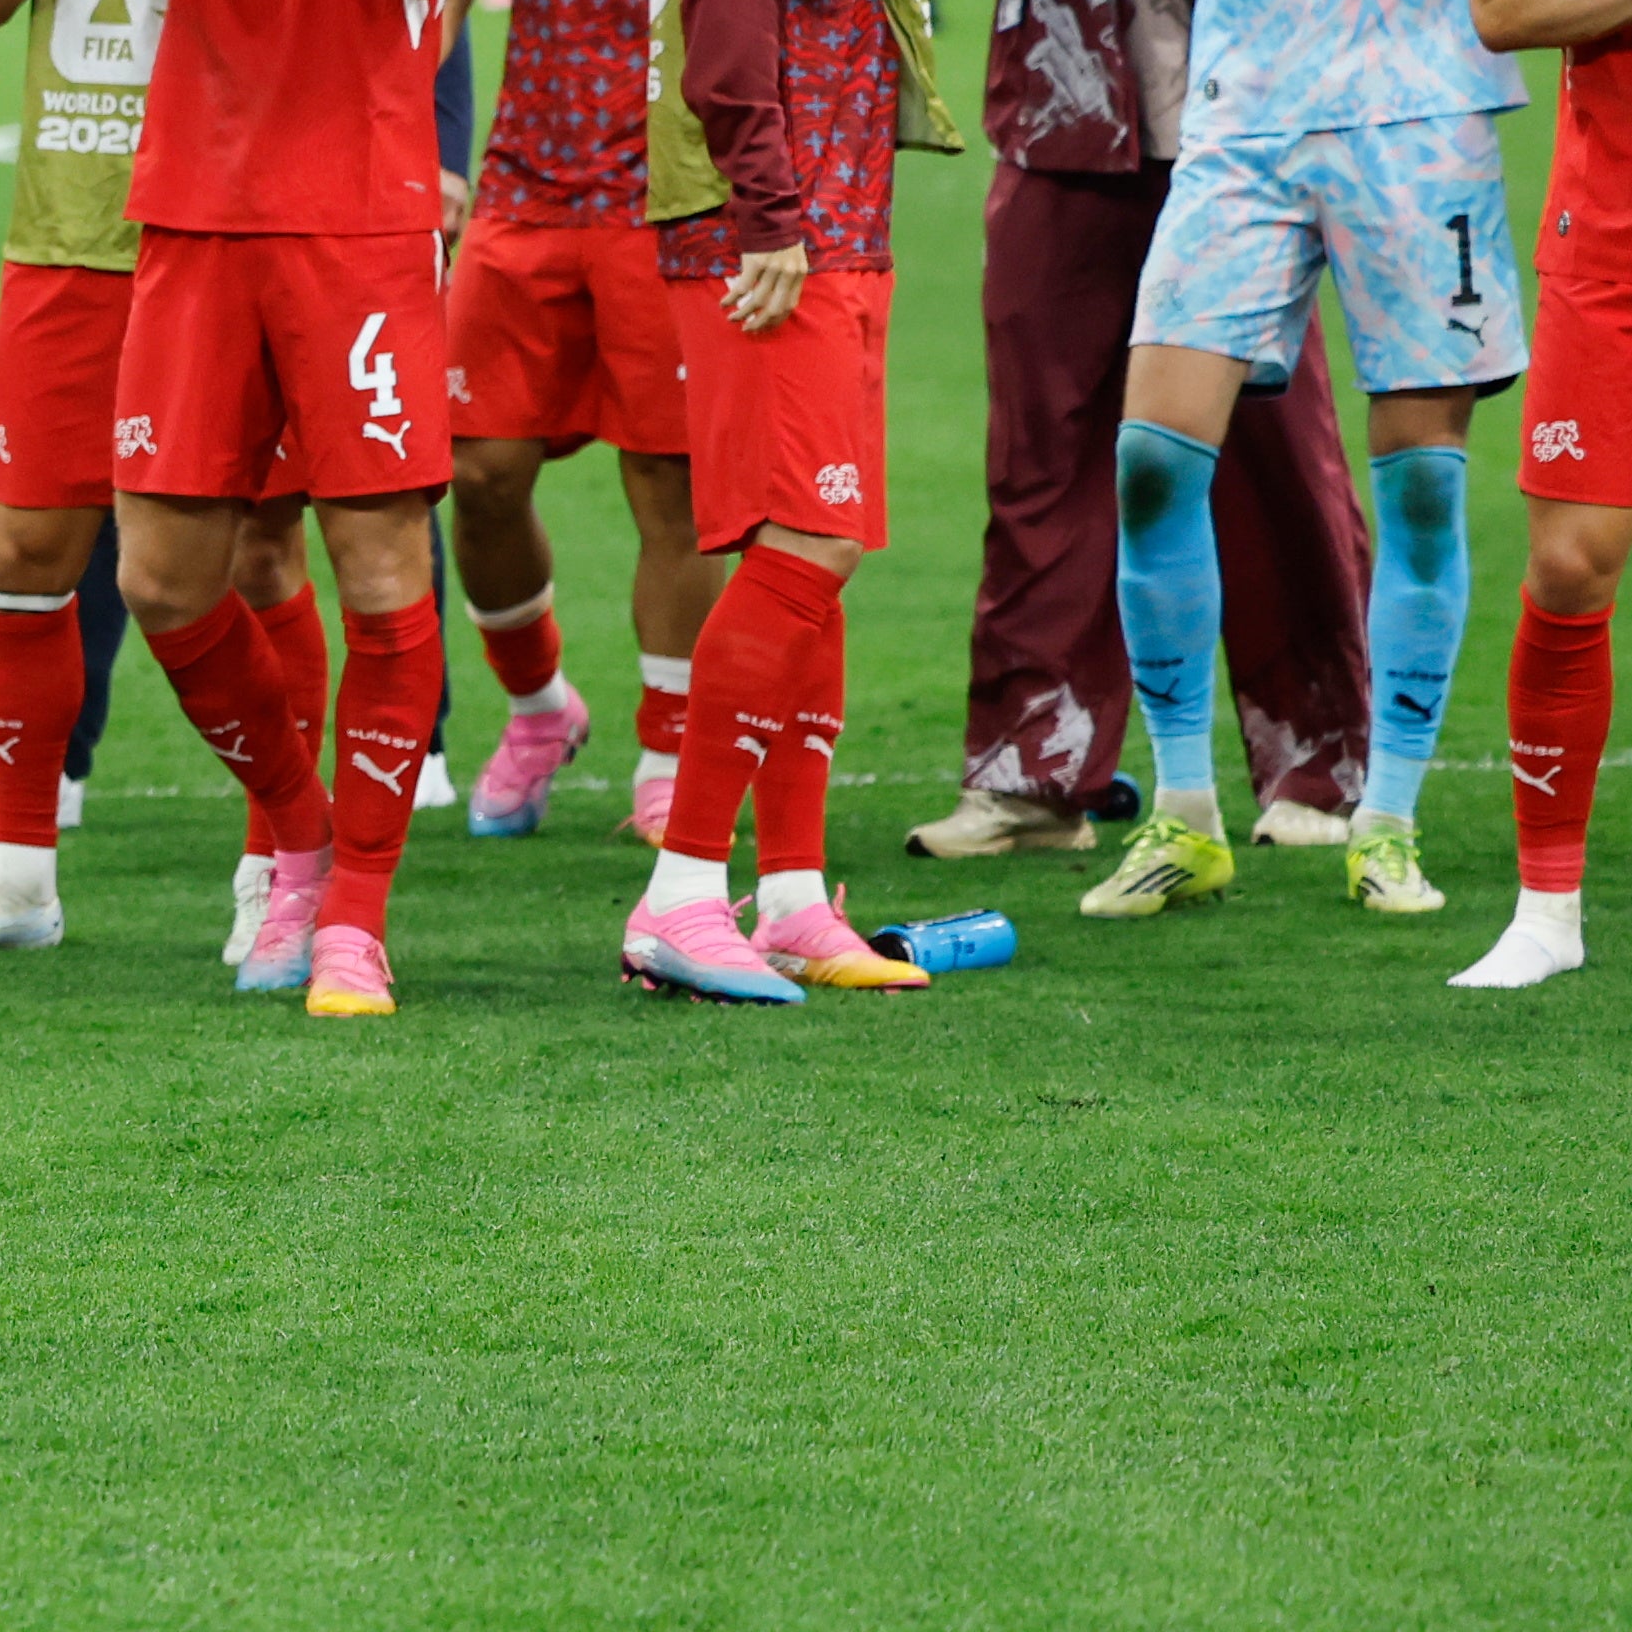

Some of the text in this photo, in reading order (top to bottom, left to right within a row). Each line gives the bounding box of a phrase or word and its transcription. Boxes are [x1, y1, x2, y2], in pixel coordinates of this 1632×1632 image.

[83, 36, 134, 62] FIFA
[42, 89, 145, 117] WORLD CU
[1447, 213, 1481, 307] 1
[349, 312, 402, 417] 4
